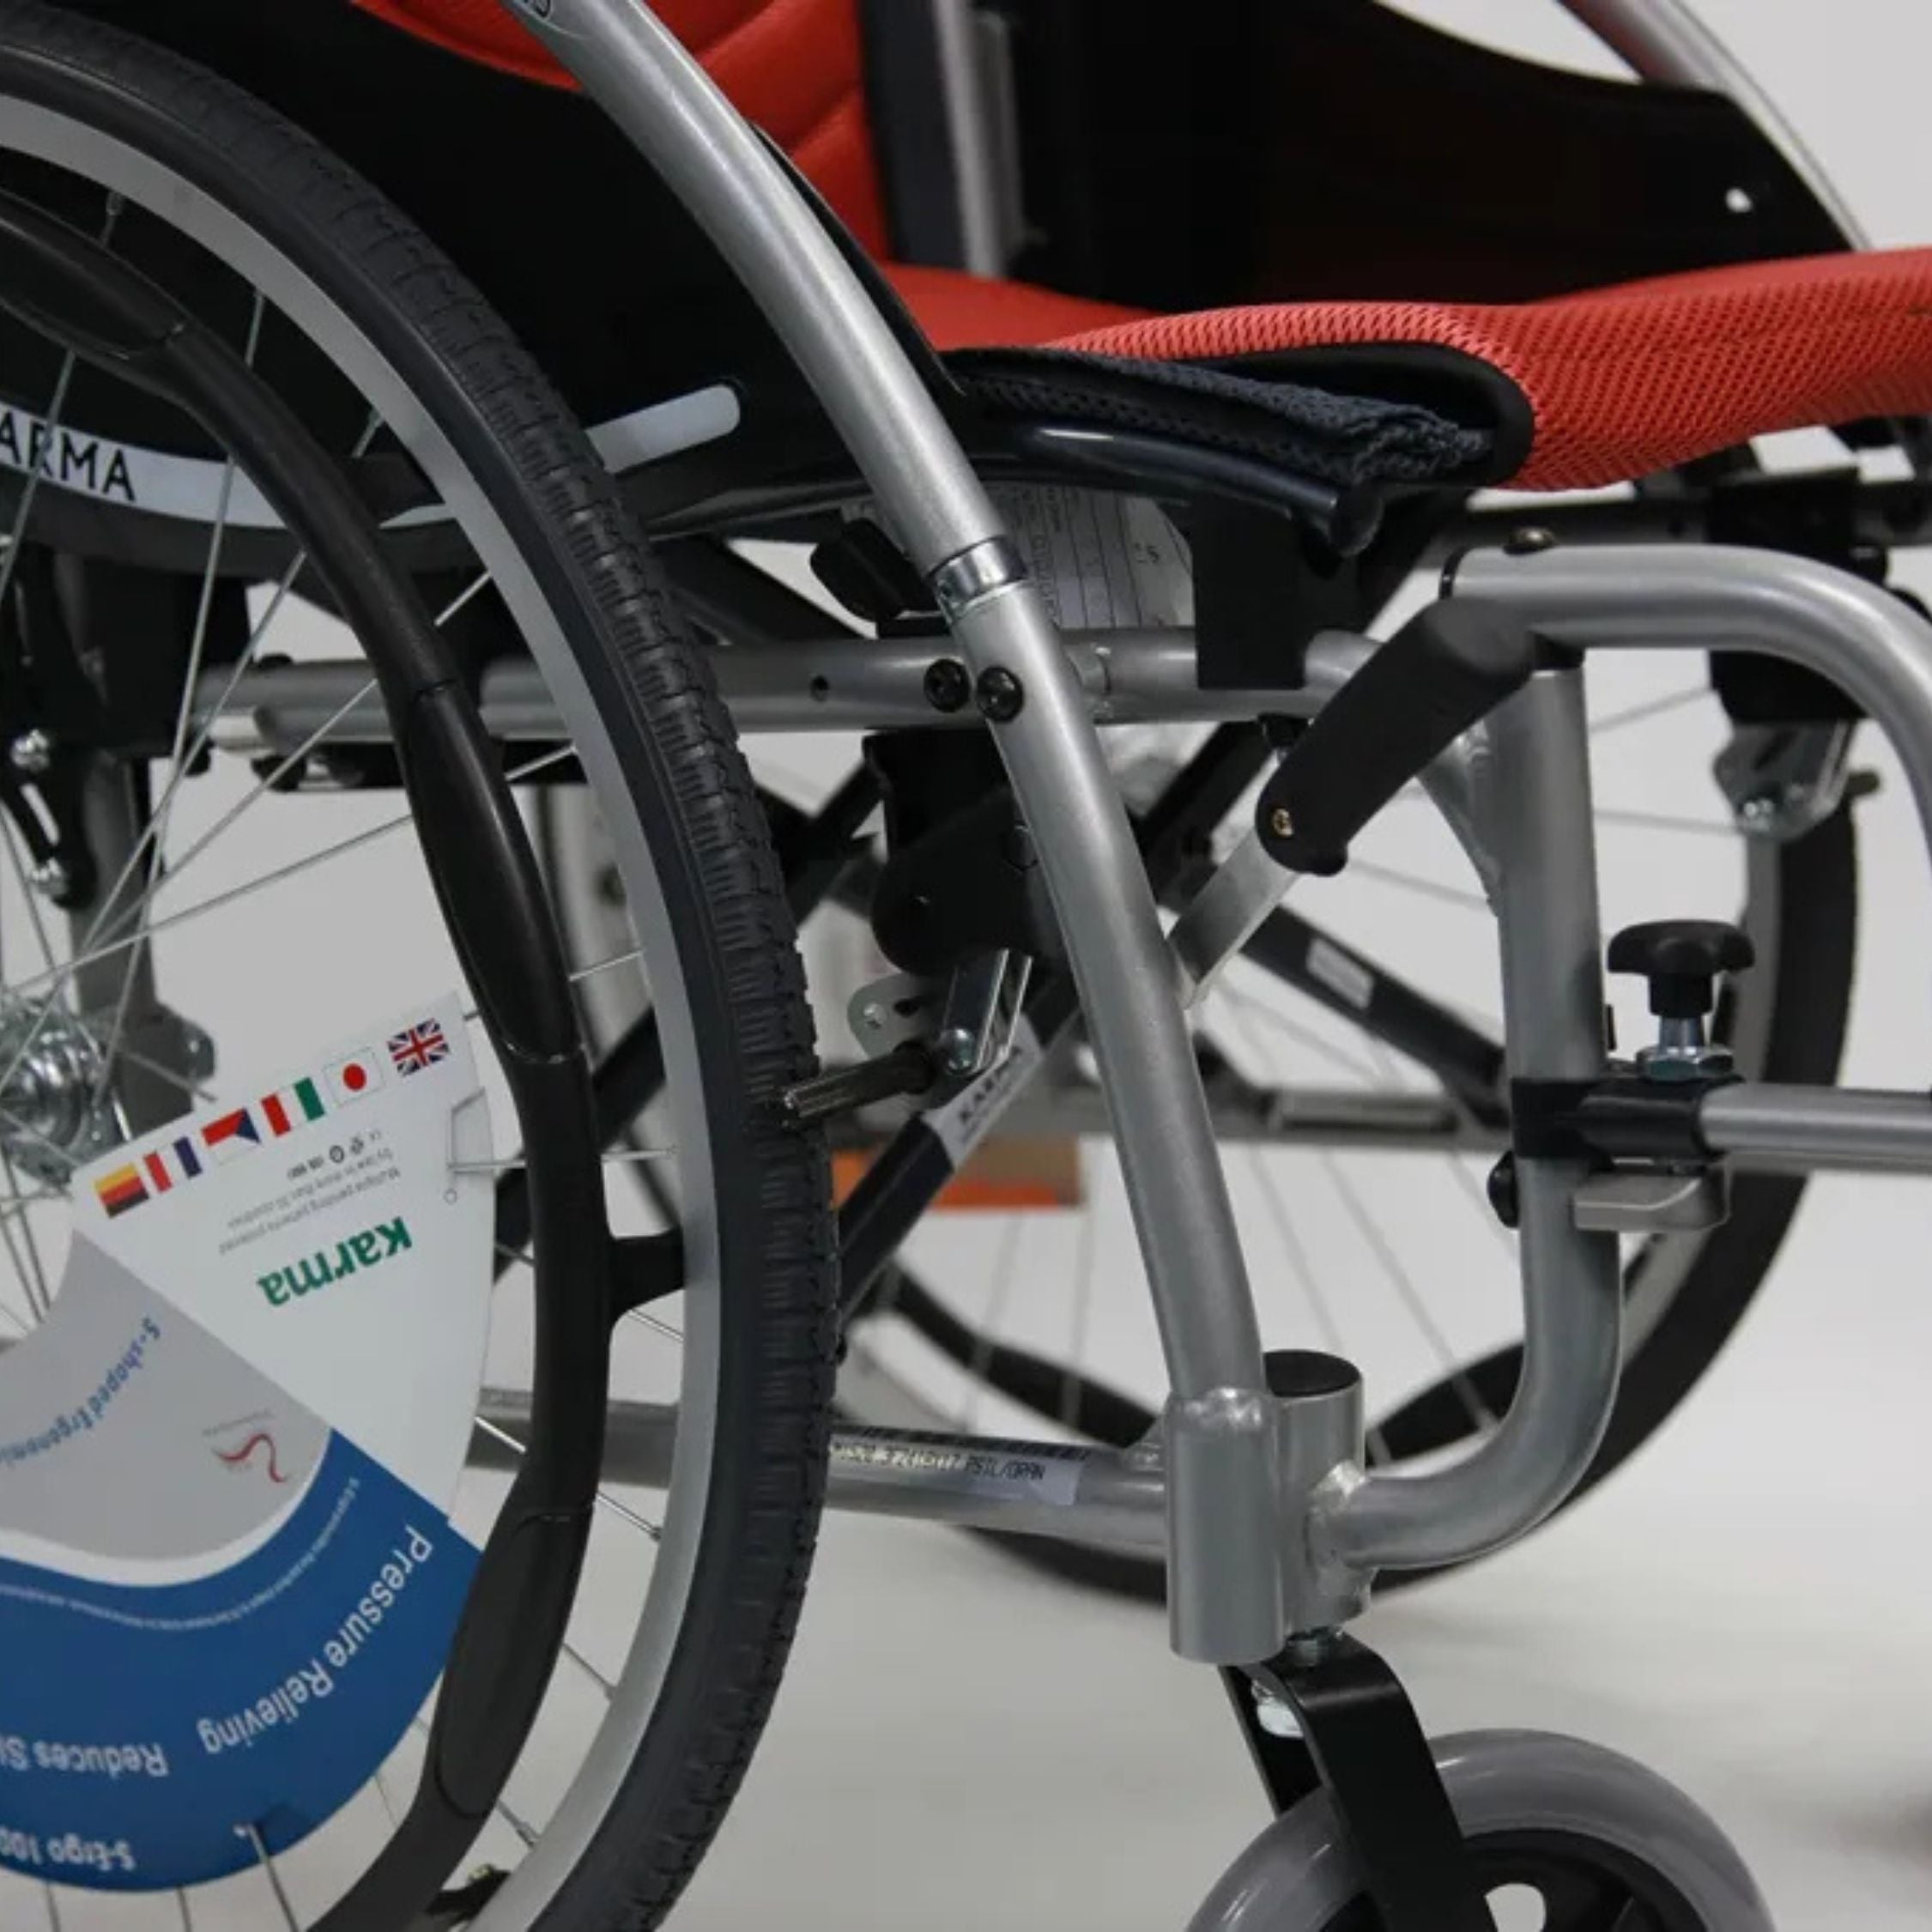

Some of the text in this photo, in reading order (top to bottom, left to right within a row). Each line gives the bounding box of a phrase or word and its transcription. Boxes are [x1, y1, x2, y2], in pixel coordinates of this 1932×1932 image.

[257, 1215, 412, 1307] karma
[323, 1523, 433, 1668] Pressure
[196, 1656, 334, 1754] Relieving
[32, 1739, 170, 1780] Reduces
